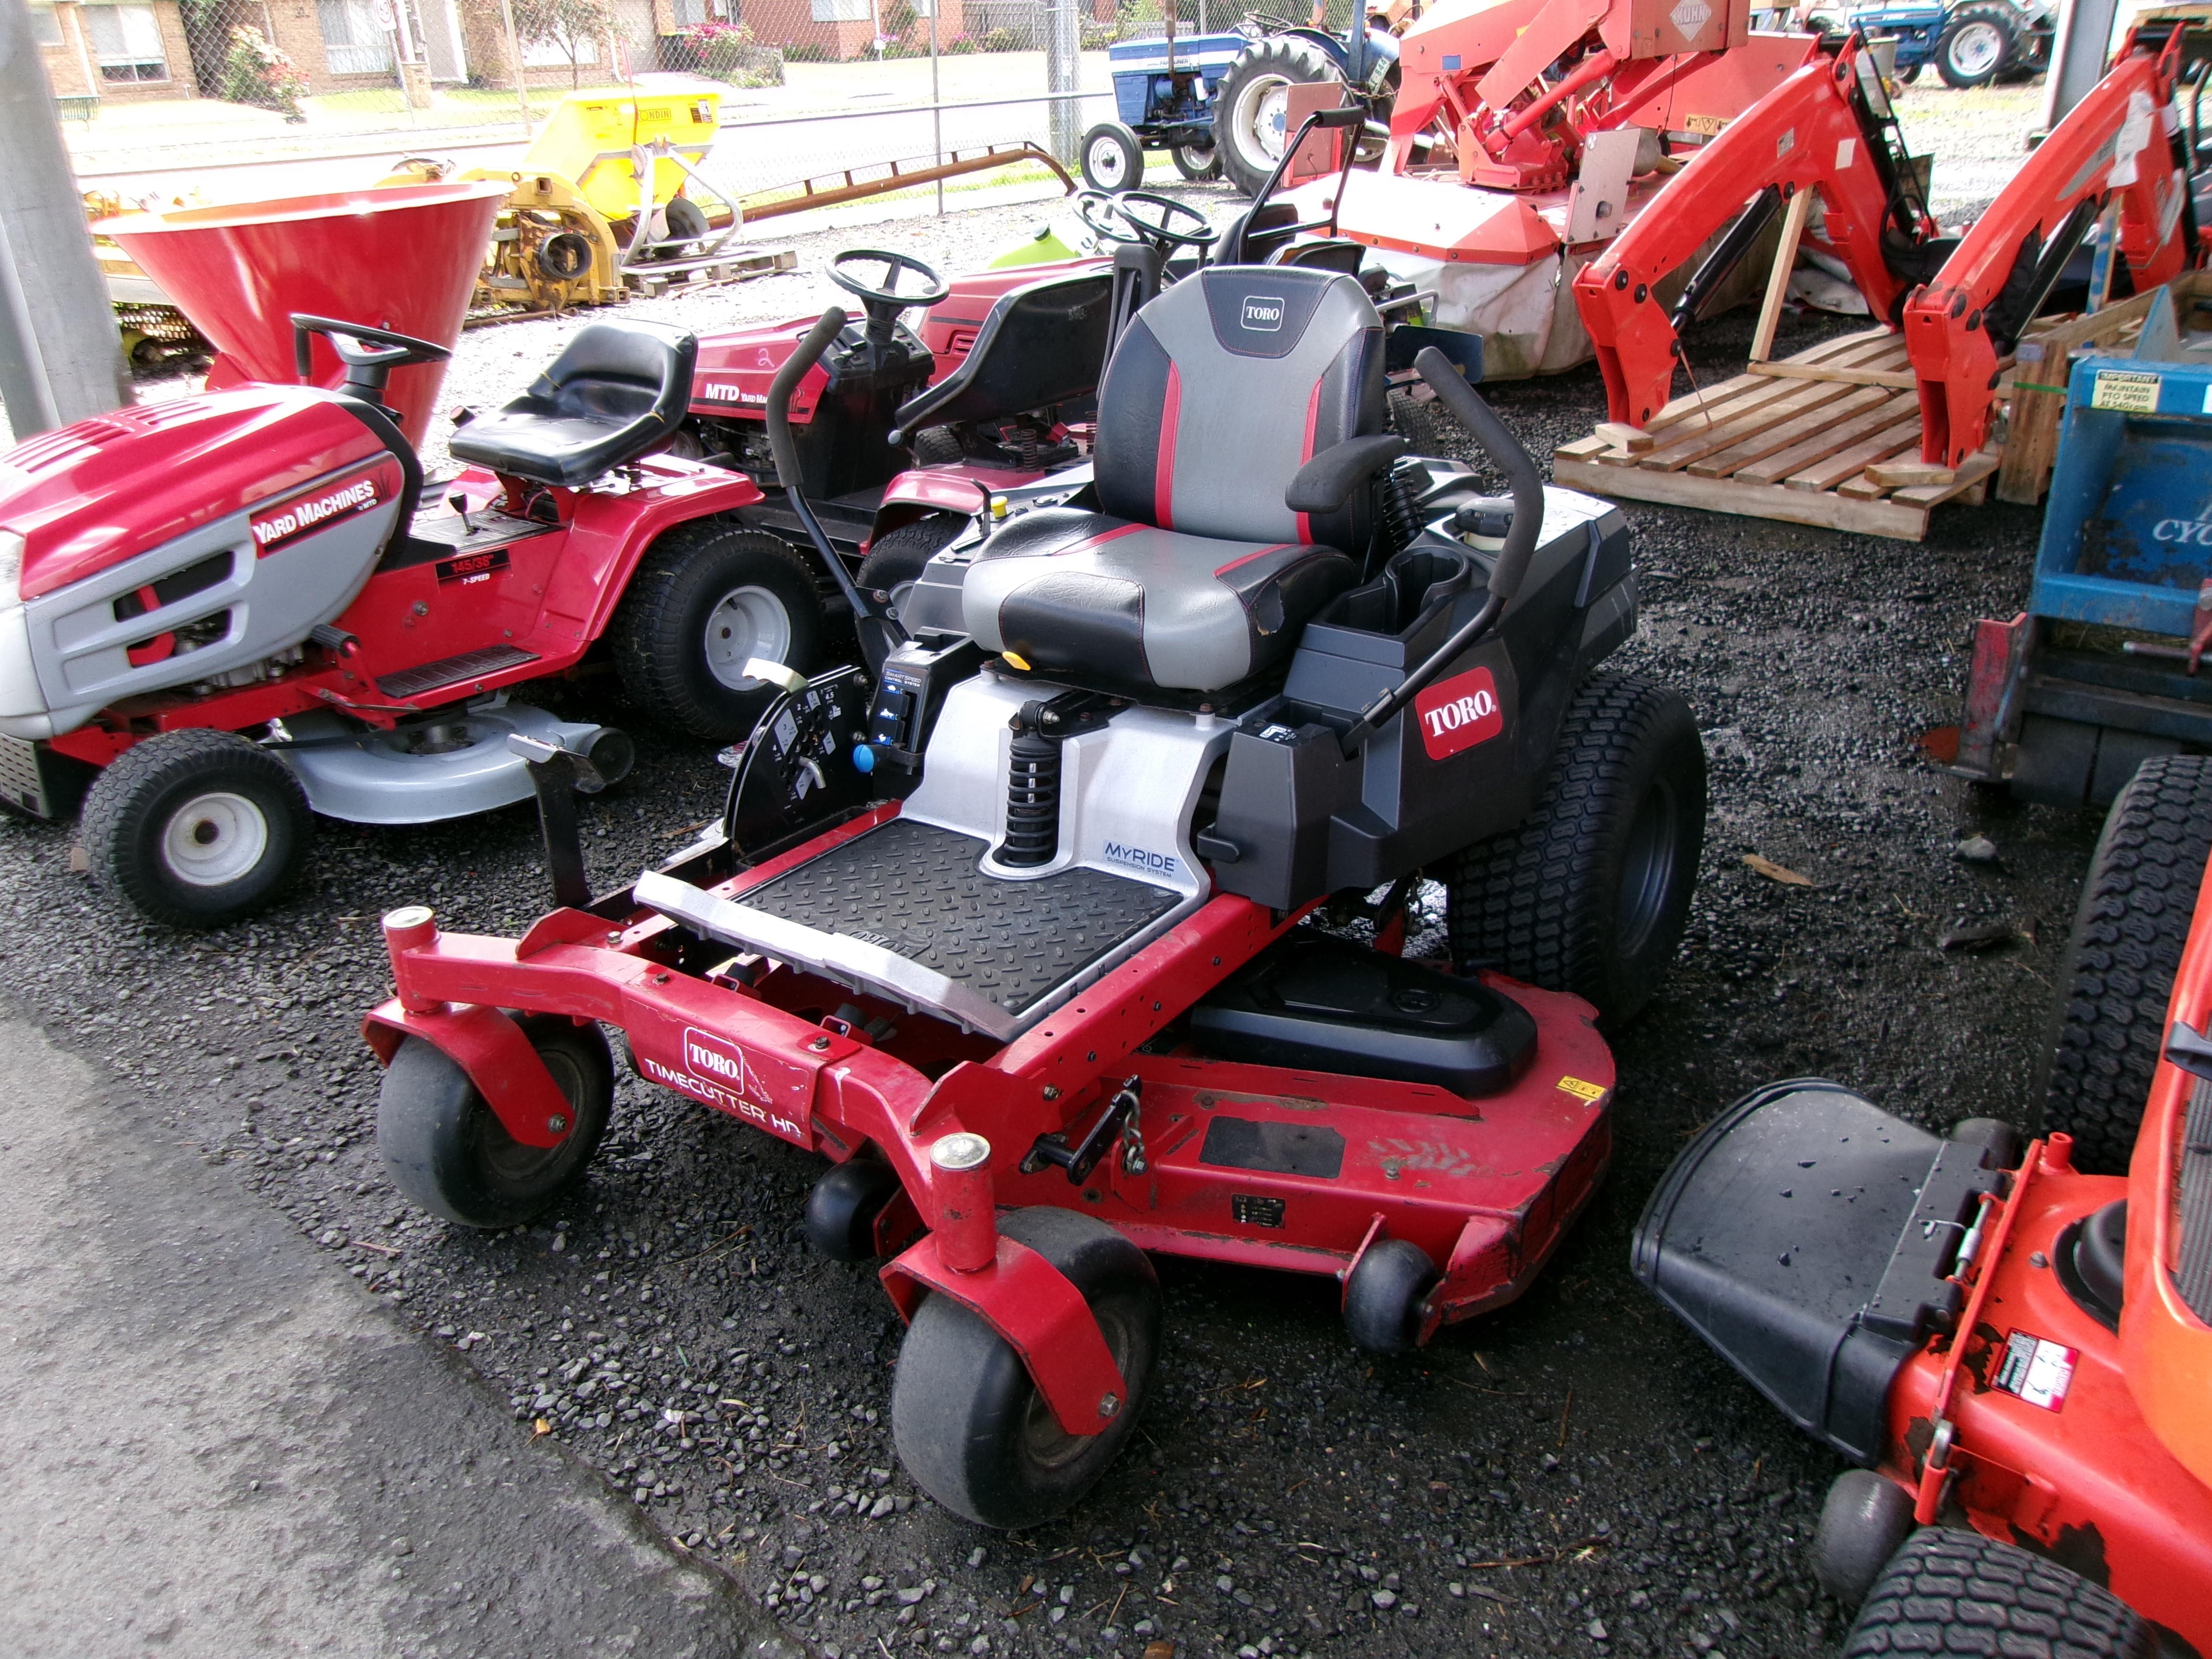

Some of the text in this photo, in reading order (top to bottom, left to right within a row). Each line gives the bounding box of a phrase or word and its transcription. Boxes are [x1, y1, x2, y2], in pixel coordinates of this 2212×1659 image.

[1675, 5, 1707, 24] KUHN
[639, 109, 672, 121] ONDINI
[1246, 306, 1280, 321] TORO
[757, 347, 775, 368] 2
[2100, 373, 2158, 384] IMPORTANT
[705, 383, 740, 401] MTD
[741, 393, 756, 402] YARD
[2102, 392, 2150, 402] PTO SPEED
[2104, 384, 2151, 393] MAINTAIN
[252, 480, 375, 544] YARD MACHINES
[362, 498, 378, 510] MTD
[463, 573, 490, 585] 7-SPEED
[1424, 690, 1492, 737] TORO
[1106, 856, 1172, 878] SUSPENSION SYSTEM
[689, 1043, 739, 1079] TORO
[645, 1058, 767, 1123] TIMECUTTER
